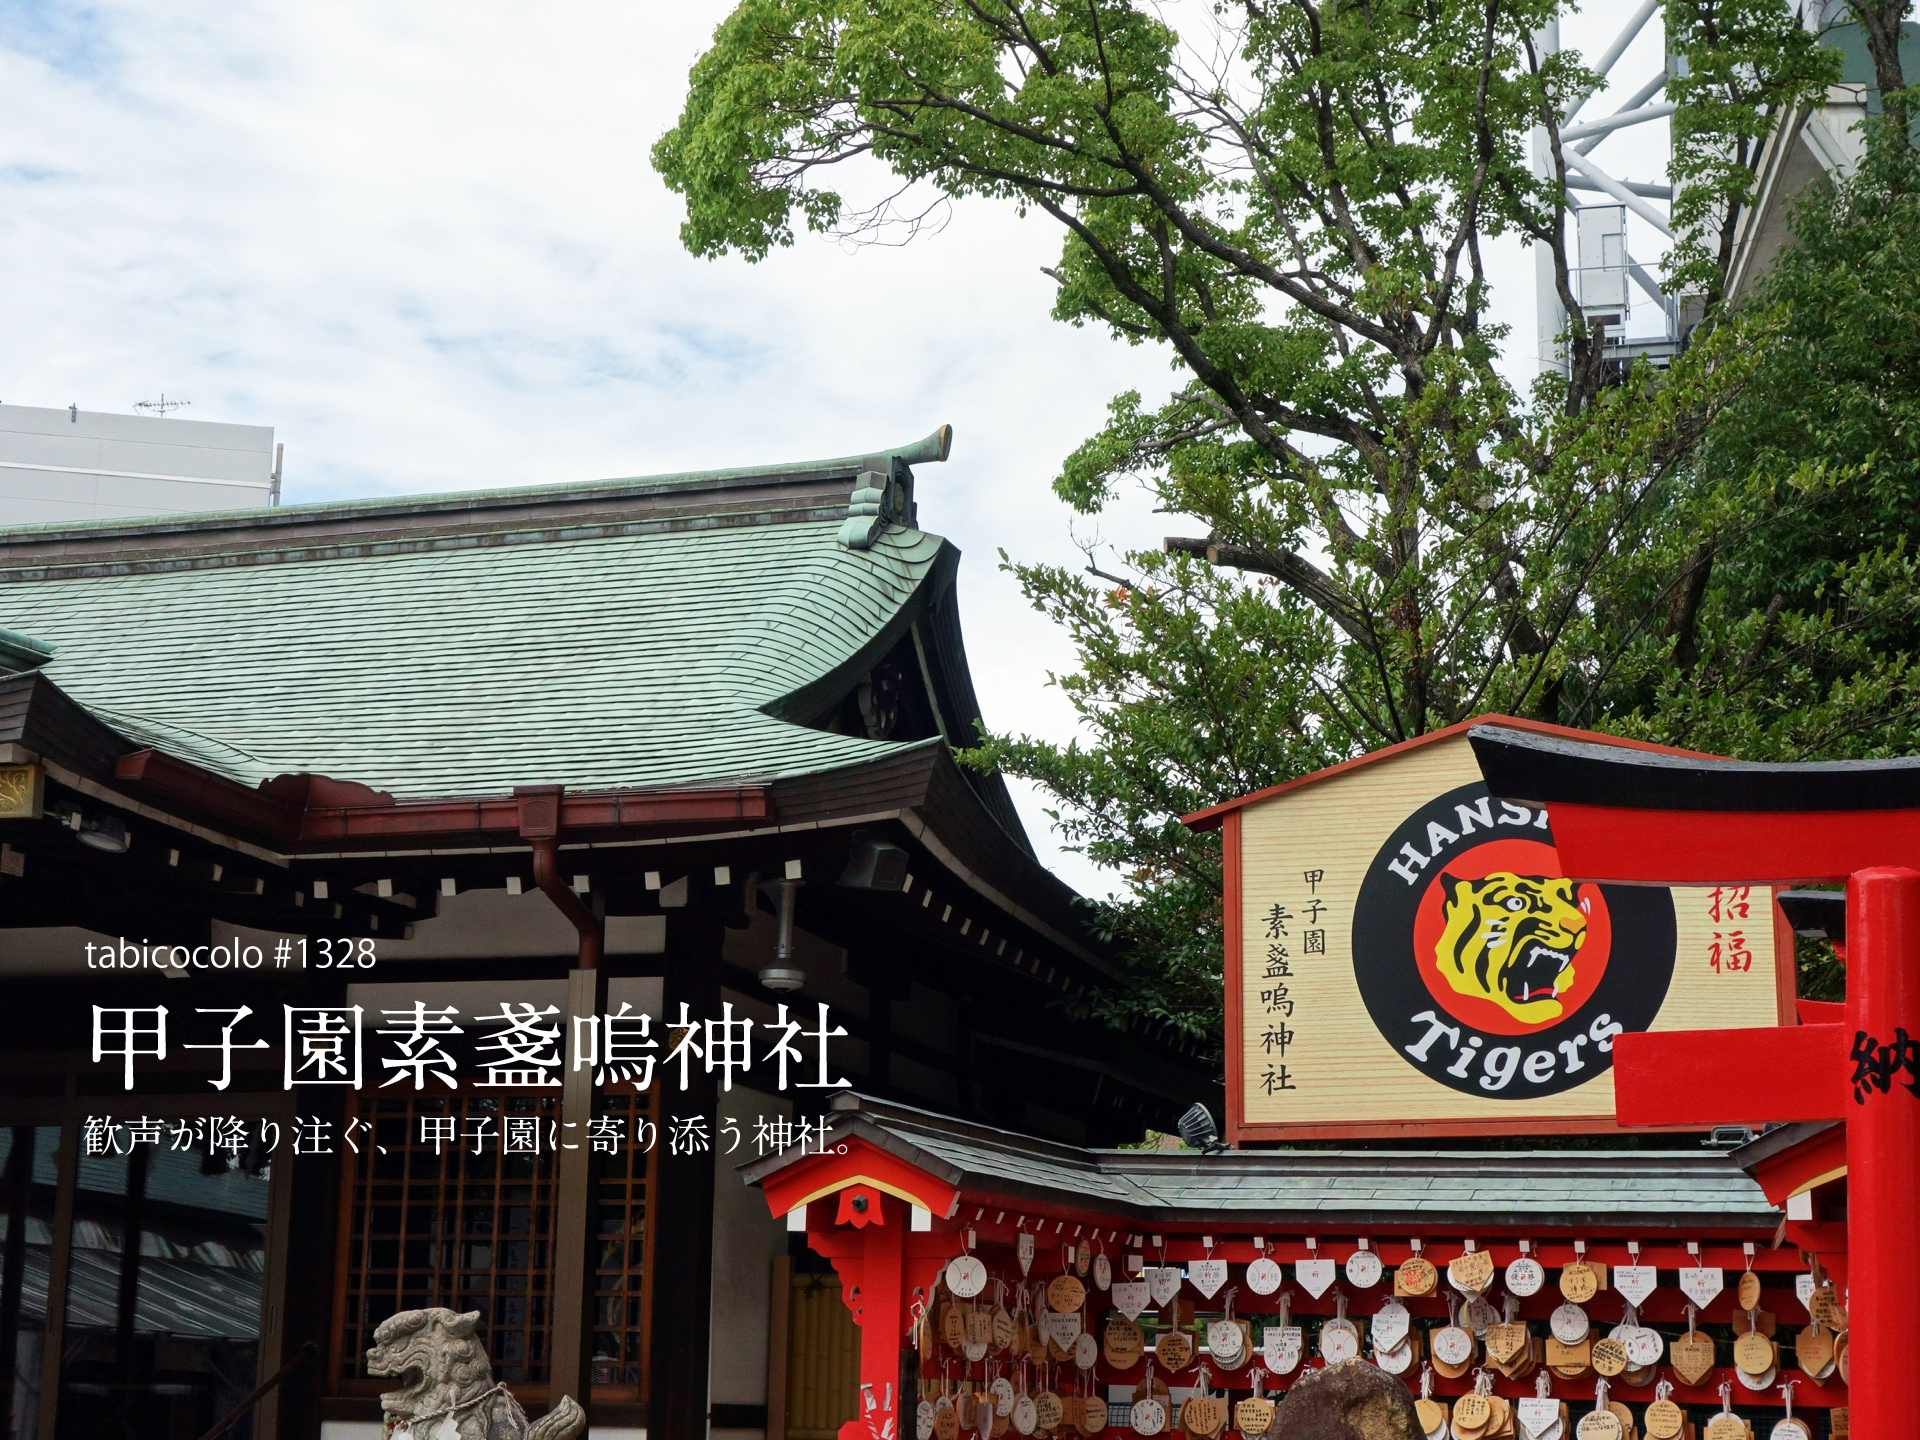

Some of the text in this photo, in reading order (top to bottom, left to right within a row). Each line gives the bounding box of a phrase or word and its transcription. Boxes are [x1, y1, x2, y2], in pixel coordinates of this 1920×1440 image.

[1302, 869, 1327, 955] 甲子園
[1707, 886, 1752, 974] 招福
[1405, 1010, 1623, 1091] Tigers
[1850, 1027, 1920, 1105] 納
